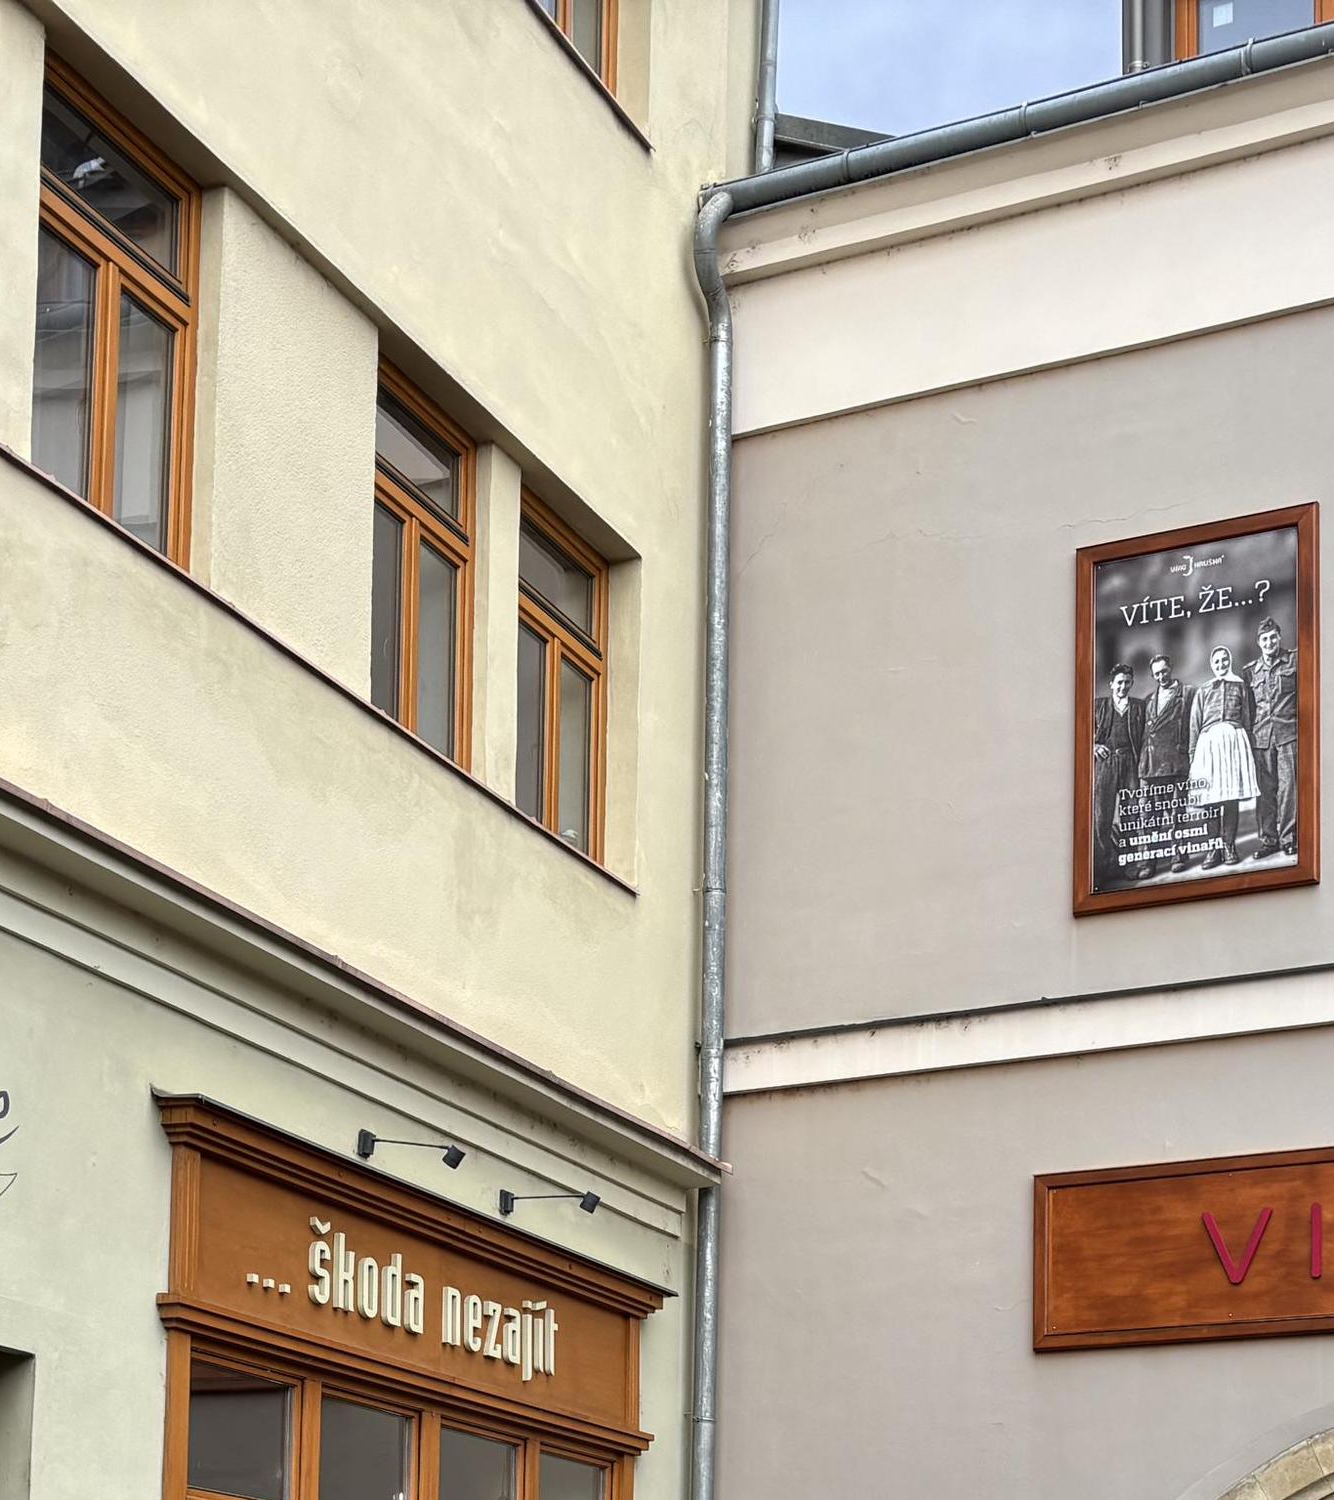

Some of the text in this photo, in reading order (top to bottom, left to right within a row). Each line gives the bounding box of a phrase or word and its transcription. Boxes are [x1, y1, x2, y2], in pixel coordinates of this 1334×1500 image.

[1120, 592, 1192, 627] VÍTE,
[1119, 784, 1174, 800] Tvoříme
[1119, 801, 1152, 816] které
[1119, 807, 1219, 832] unikátní terroir
[1118, 823, 1208, 848] a umění osmi
[1118, 844, 1176, 866] generací
[307, 1216, 425, 1334] škoda
[441, 1286, 559, 1382] nezajít
